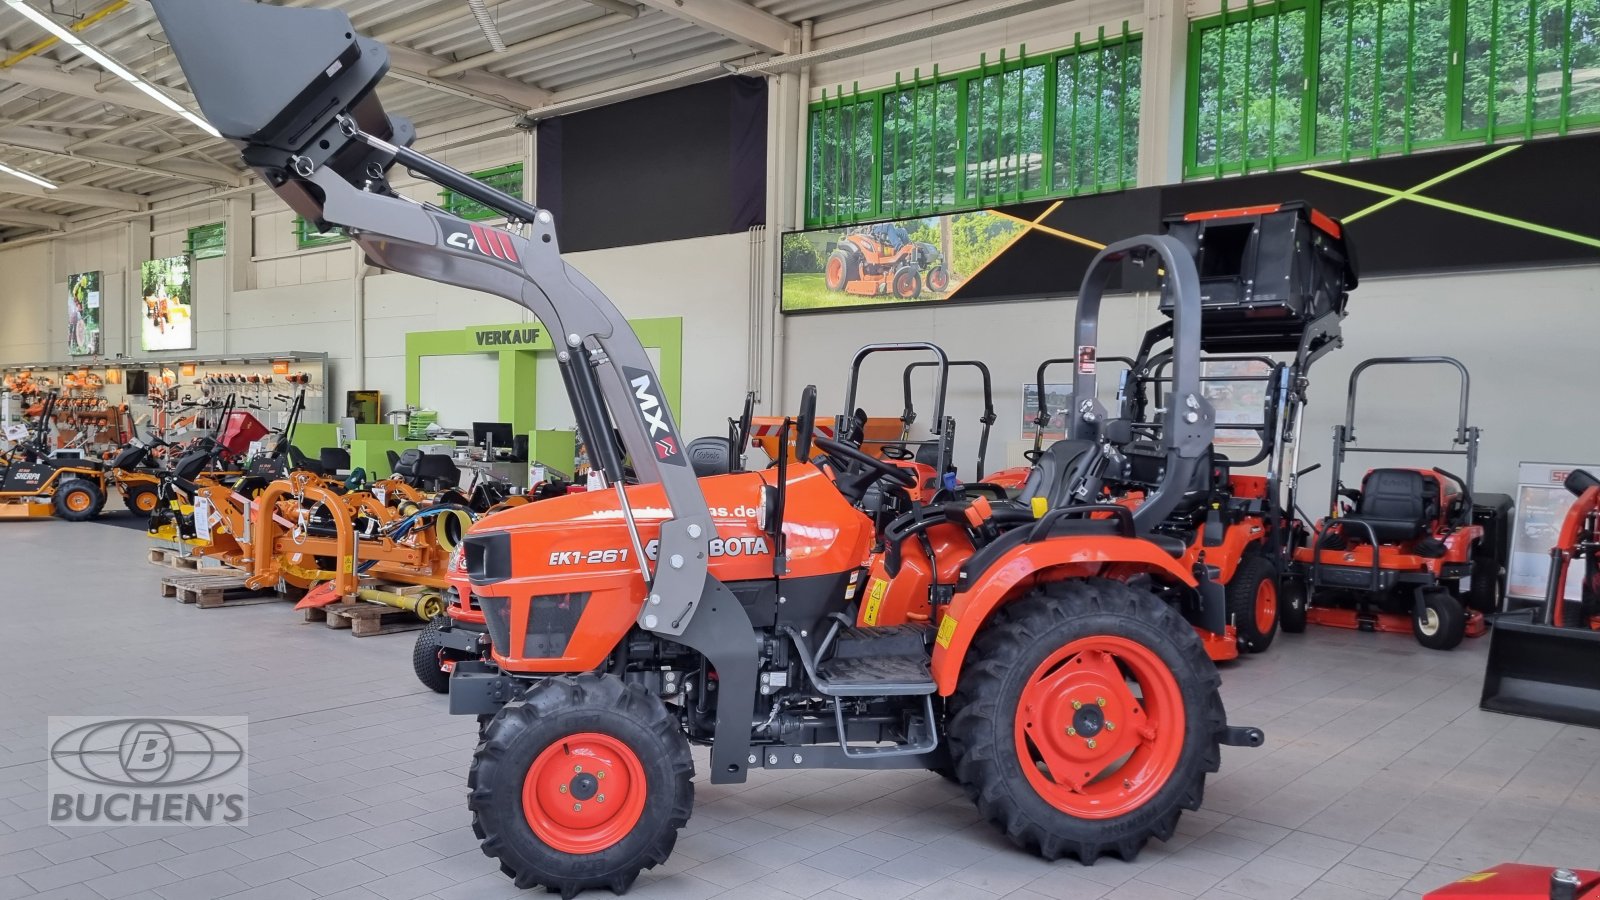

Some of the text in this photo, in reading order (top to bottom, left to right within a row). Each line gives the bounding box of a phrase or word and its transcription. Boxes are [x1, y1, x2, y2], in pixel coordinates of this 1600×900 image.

[446, 232, 475, 251] C1
[475, 329, 540, 346] VERKAUF
[630, 374, 670, 438] MX
[14, 472, 41, 480] SHERPA
[709, 536, 770, 557] BOTA
[548, 548, 629, 566] EK1-261
